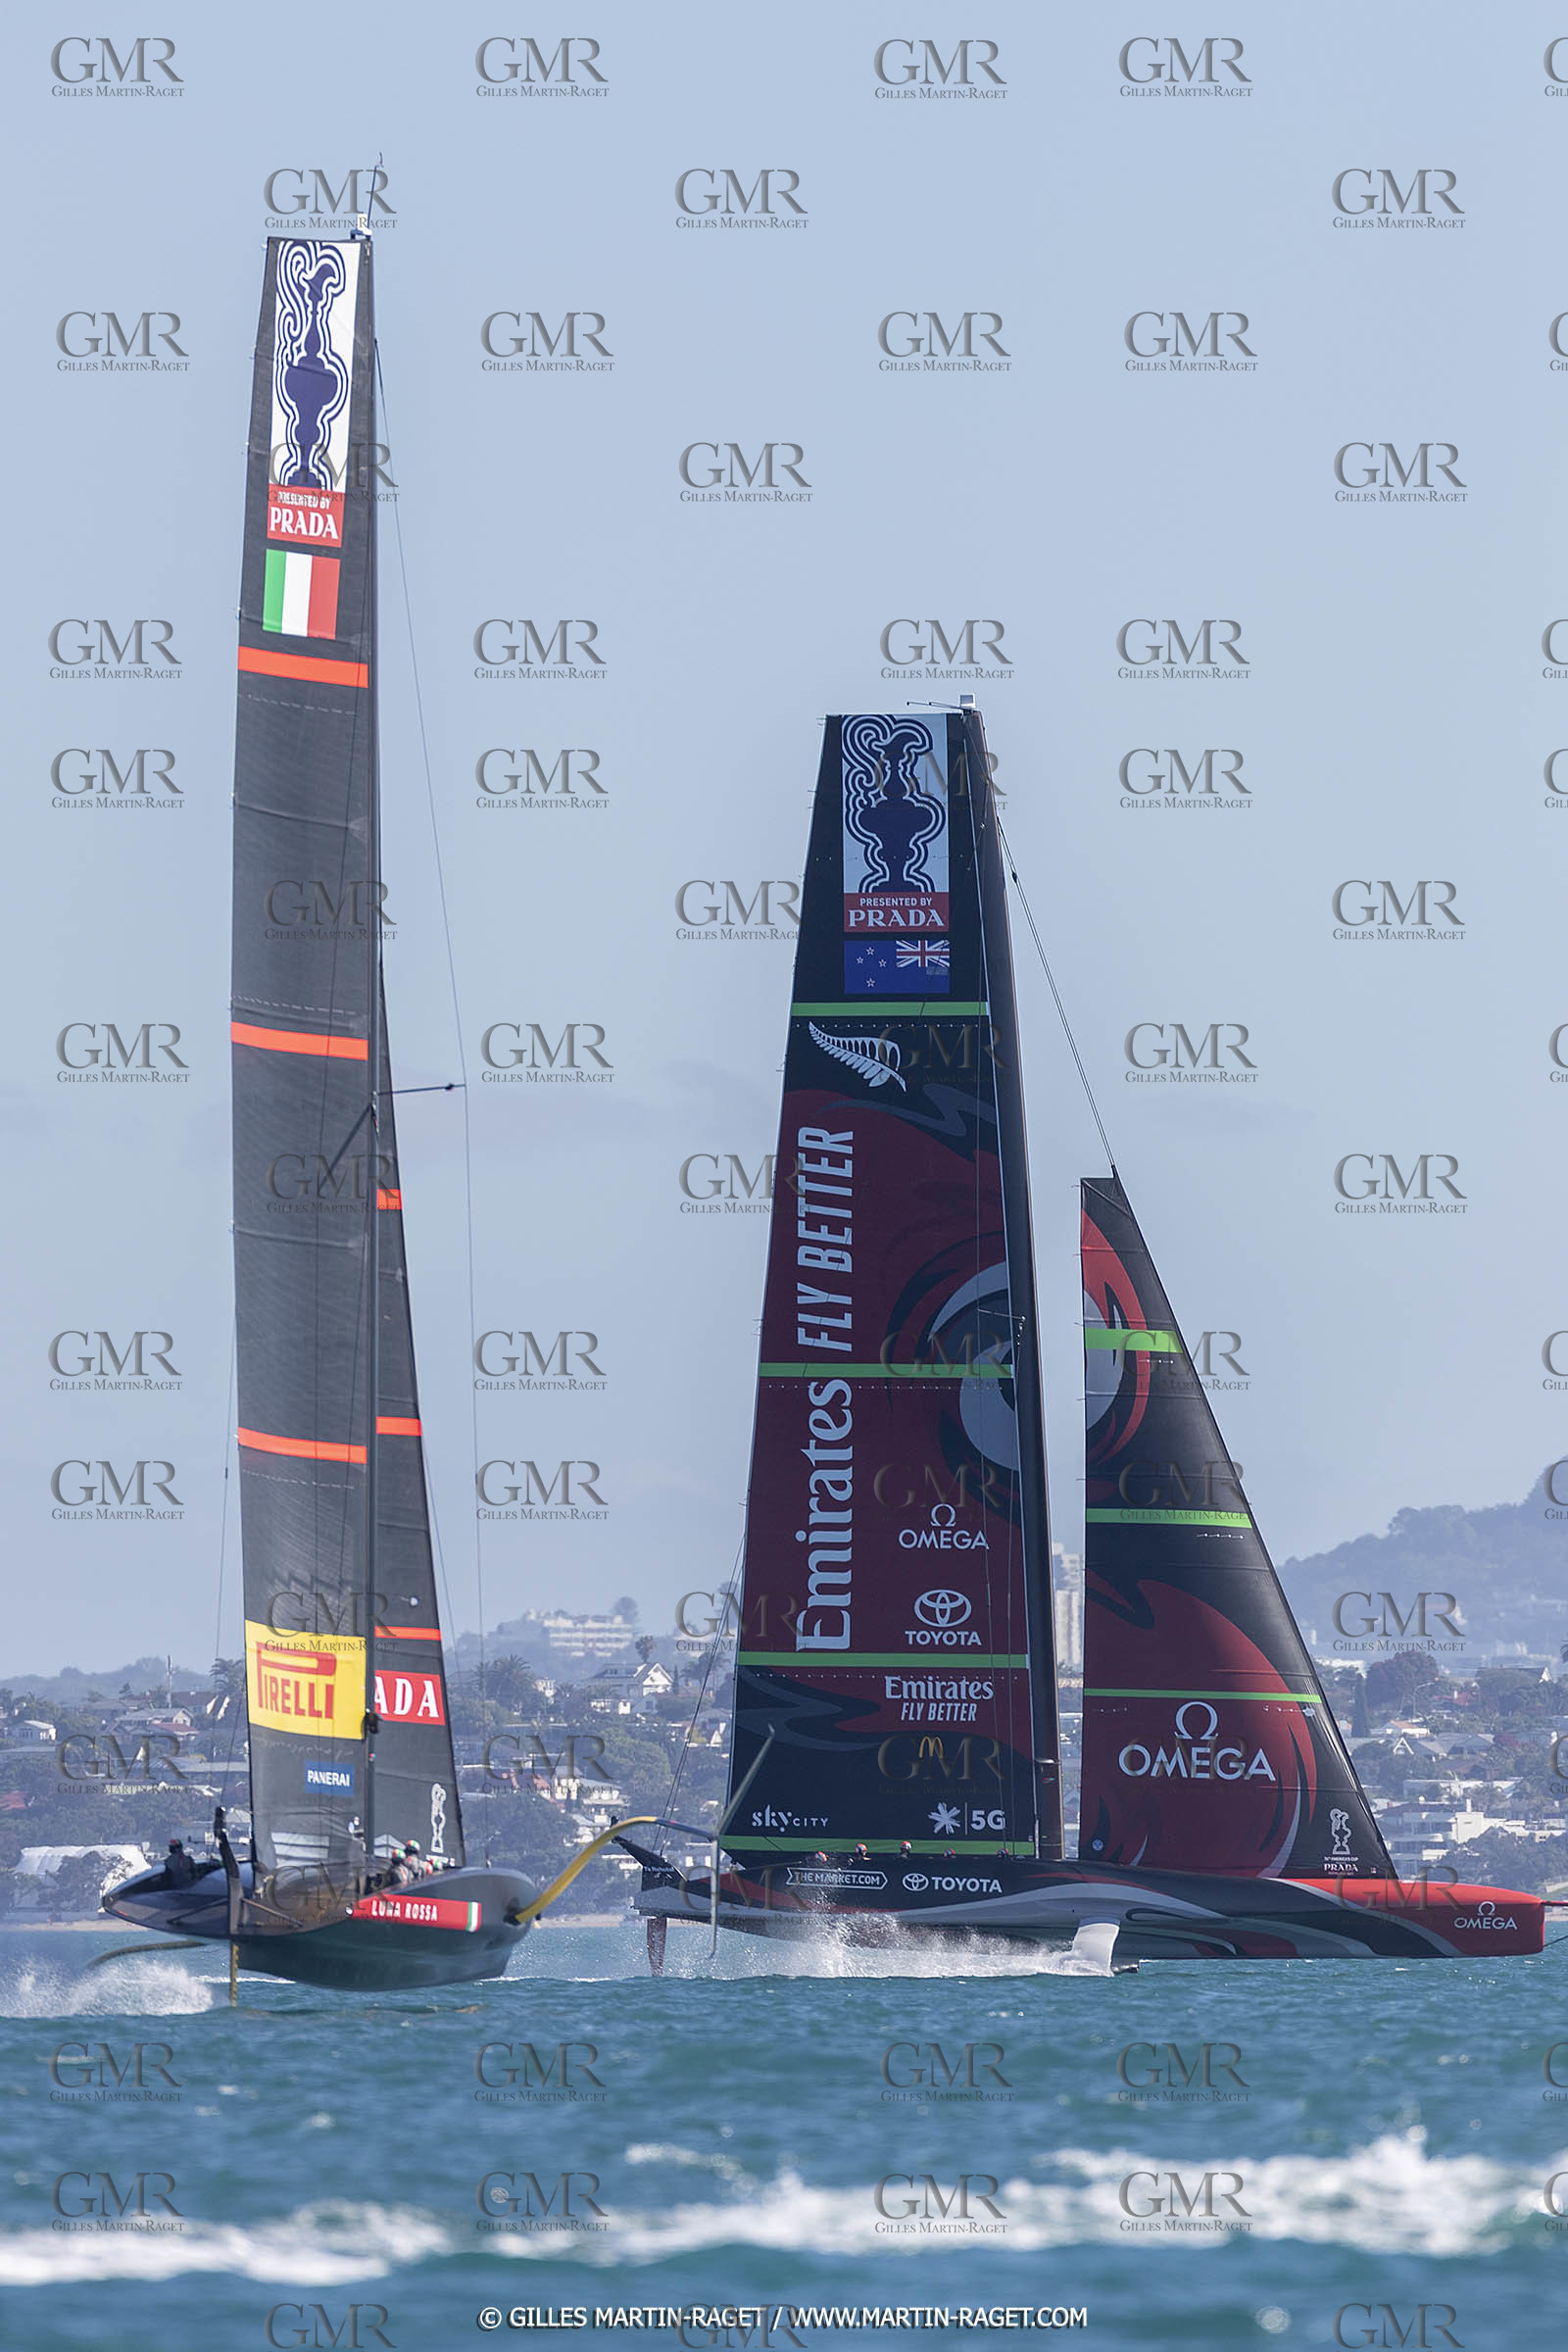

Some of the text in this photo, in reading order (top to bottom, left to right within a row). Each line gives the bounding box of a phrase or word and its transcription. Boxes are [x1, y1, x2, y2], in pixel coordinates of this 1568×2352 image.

[270, 506, 339, 540] PRADA
[859, 897, 932, 906] PRESENTED BY
[848, 908, 945, 927] PRADA
[795, 1125, 855, 1652] Emirates FLY BETTER
[898, 1528, 990, 1550] OMEGA
[905, 1630, 982, 1645] TOYOTA
[256, 1642, 337, 1719] PIRELLI
[885, 1675, 994, 1700] Emirates
[374, 1676, 440, 1718] ADA
[901, 1701, 977, 1722] FLY BETTER
[1118, 1743, 1277, 1782] OMEGA
[307, 1770, 351, 1788] PANERAI
[970, 1809, 1005, 1831] 5G
[1324, 1863, 1358, 1872] PRADA
[931, 1876, 1003, 1893] TOYOTA
[405, 1903, 438, 1922] ROSSA
[1453, 1917, 1518, 1930] OMEGA
